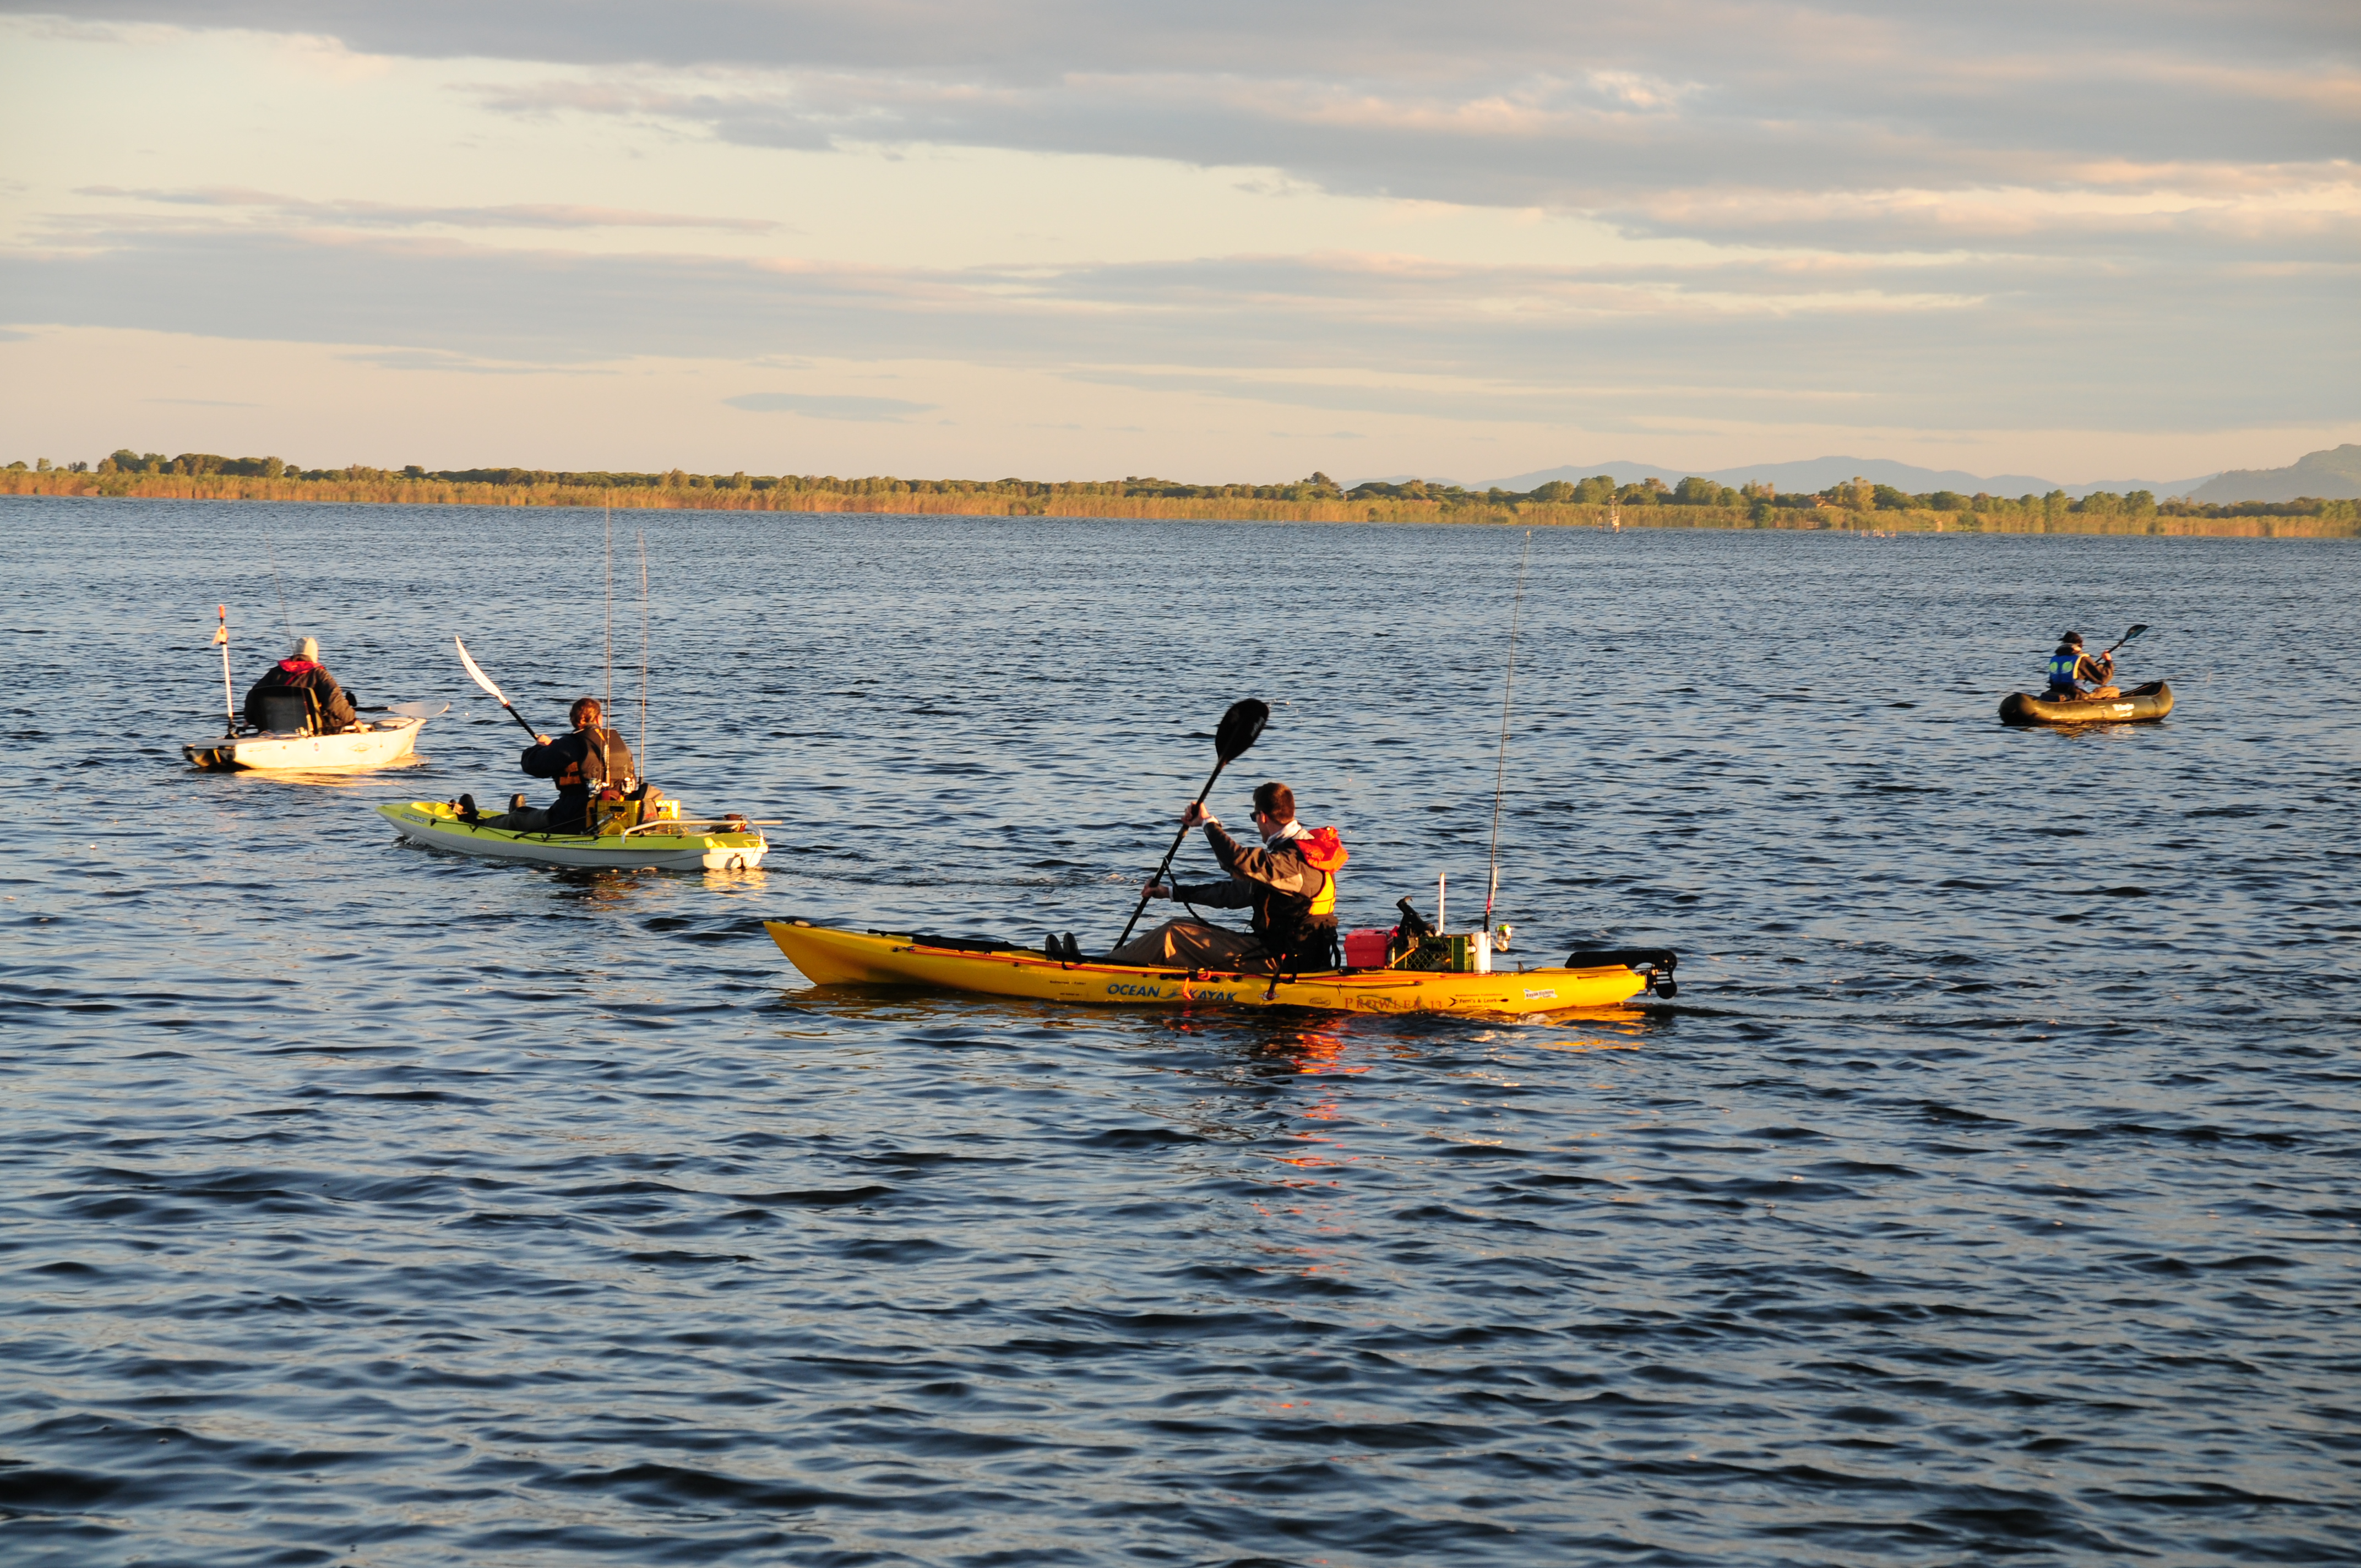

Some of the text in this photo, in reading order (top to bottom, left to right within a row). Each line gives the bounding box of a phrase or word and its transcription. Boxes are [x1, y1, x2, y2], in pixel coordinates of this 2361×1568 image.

[1107, 983, 1237, 1001] OCEAN KAYAK
[1345, 998, 1441, 1010] PROWLER 13
